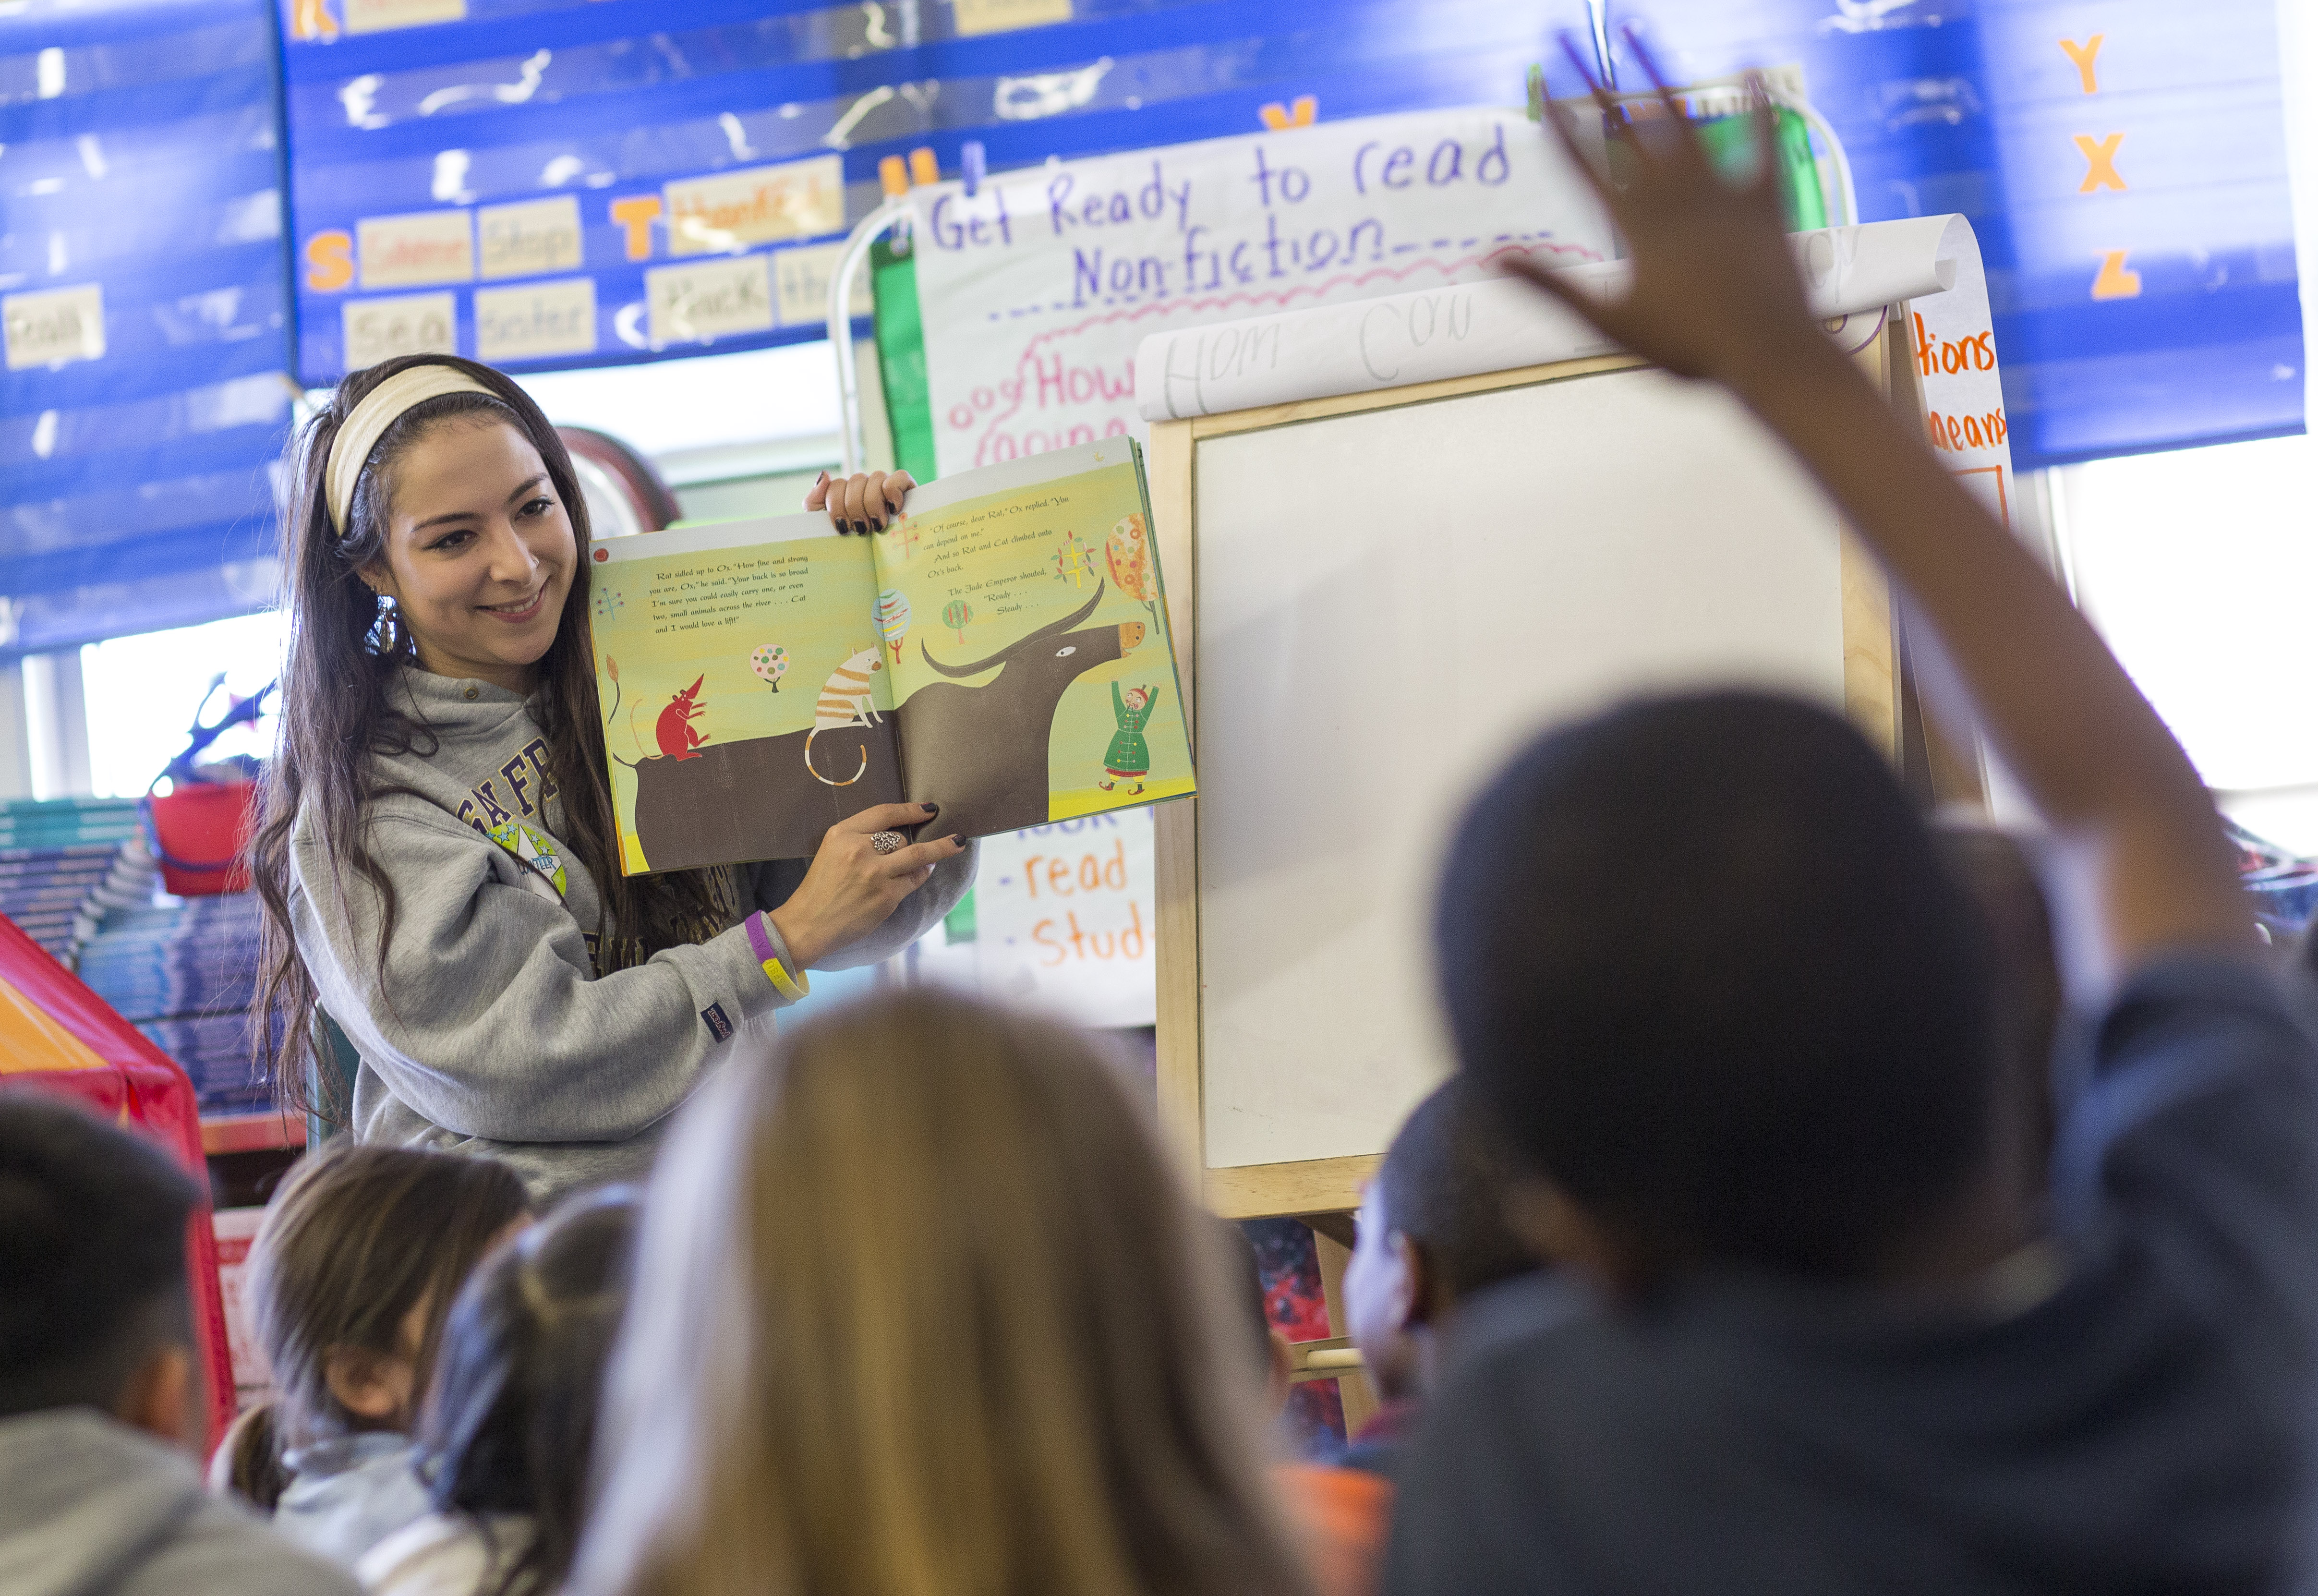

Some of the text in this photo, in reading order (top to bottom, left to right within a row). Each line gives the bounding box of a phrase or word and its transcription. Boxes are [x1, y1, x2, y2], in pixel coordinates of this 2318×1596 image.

[2058, 33, 2105, 93] Y
[2073, 133, 2128, 193] X
[930, 123, 1510, 251] Get Ready to read
[611, 197, 662, 260] T
[307, 232, 353, 290] S
[2091, 250, 2142, 301] Z
[1036, 352, 1135, 409] How
[946, 520, 968, 530] course,
[1010, 506, 1023, 514] Ox
[1026, 499, 1050, 511] replied.
[934, 551, 950, 563] And
[962, 545, 976, 555] Rat
[979, 541, 991, 550] and
[994, 538, 1008, 547] Cat
[1011, 532, 1035, 543] climbed
[936, 535, 957, 547] depend
[675, 569, 693, 578] sidled
[758, 559, 769, 568] fine
[712, 578, 726, 586] said.
[789, 567, 808, 576] broad
[928, 564, 964, 578] Ox's back.
[947, 568, 1047, 596] The Jade Emperor shouted,
[670, 609, 687, 618] small
[690, 606, 716, 615] animals
[700, 592, 717, 601] could
[997, 603, 1022, 615] Steady
[679, 621, 699, 630] would
[1024, 838, 1127, 899] read
[1031, 901, 1150, 966] Stud
